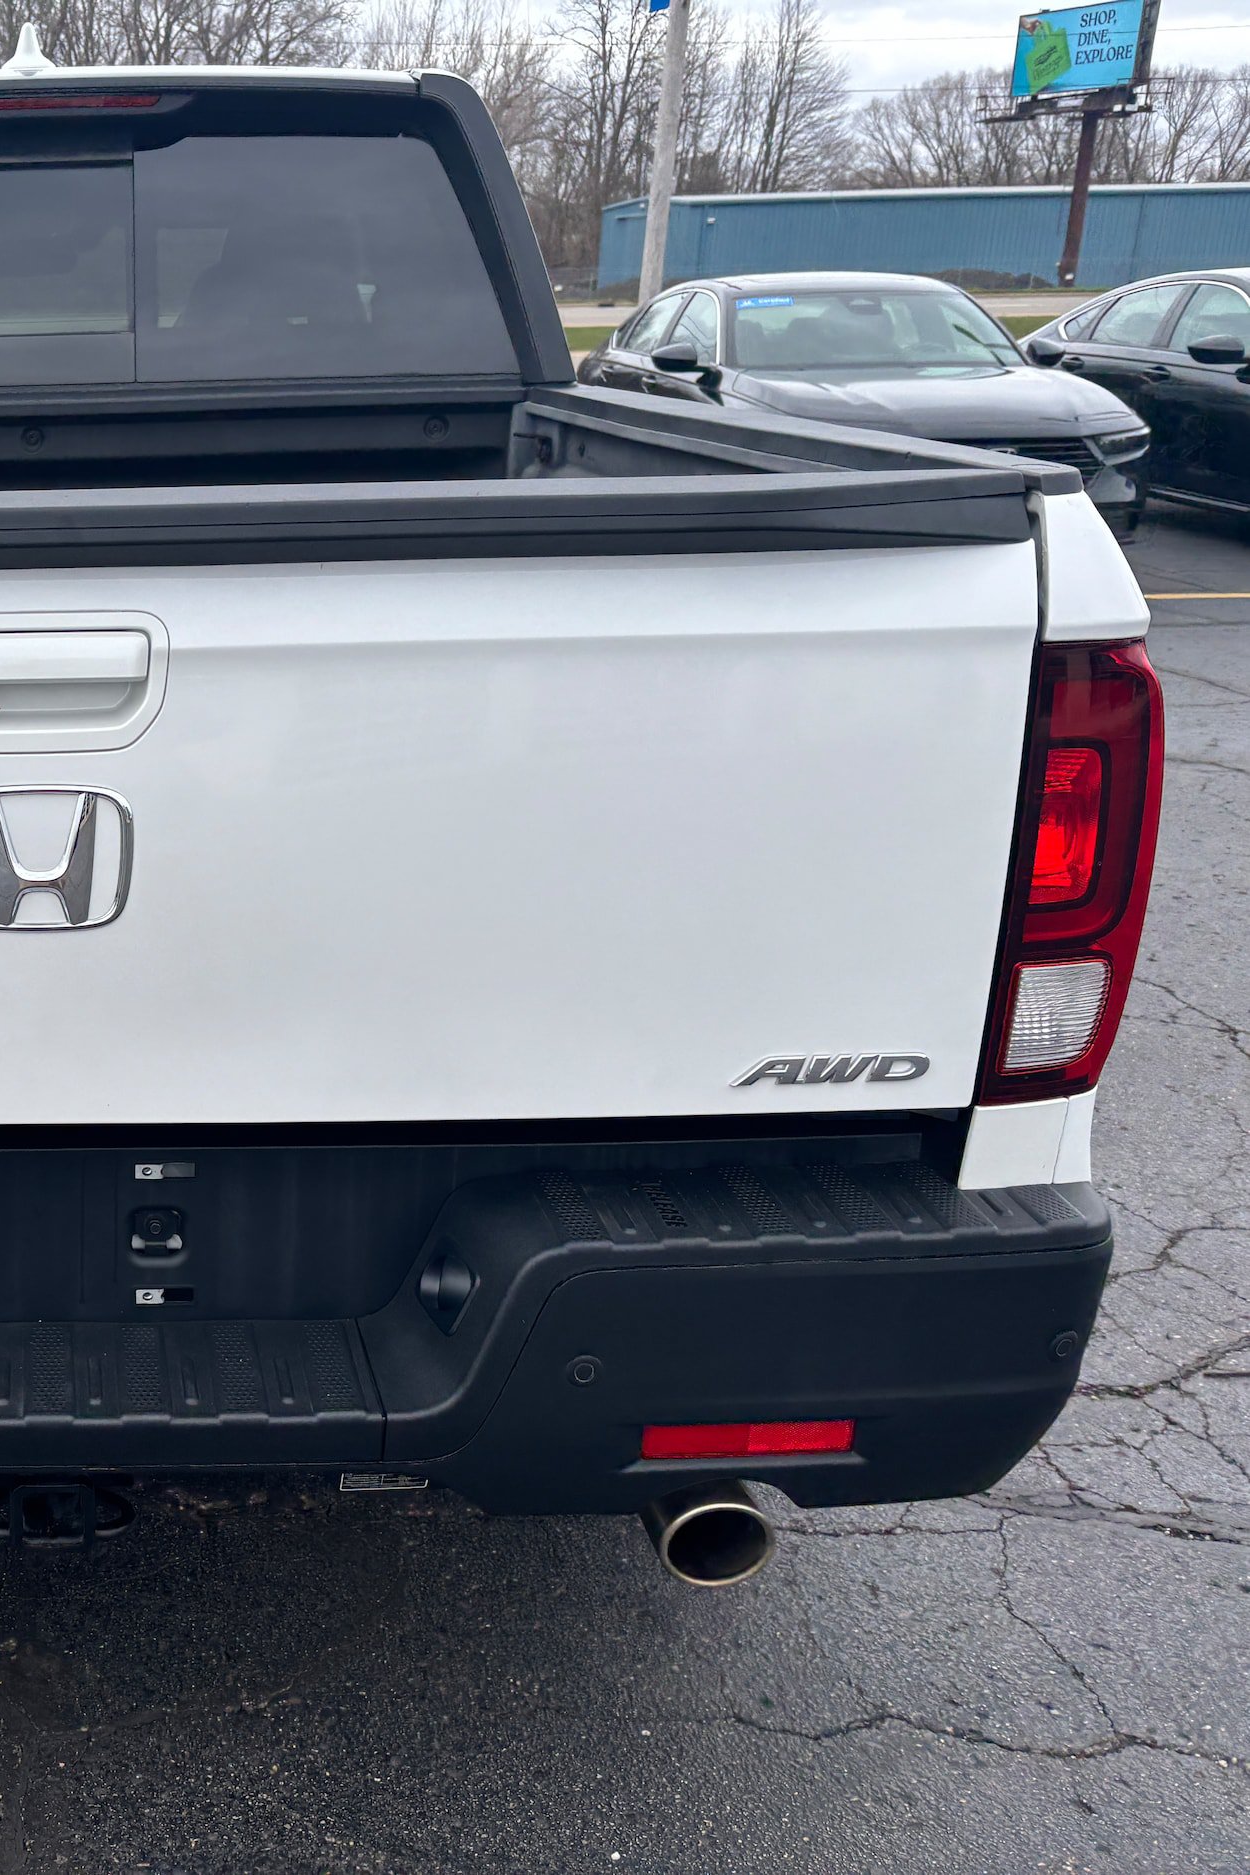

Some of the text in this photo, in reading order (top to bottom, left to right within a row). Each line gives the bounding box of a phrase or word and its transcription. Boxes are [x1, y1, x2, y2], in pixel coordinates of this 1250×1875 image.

[1080, 9, 1117, 28] SHOP,
[1078, 29, 1111, 47] DINE,
[1075, 44, 1134, 65] EXPLORE
[728, 1052, 931, 1088] AWD
